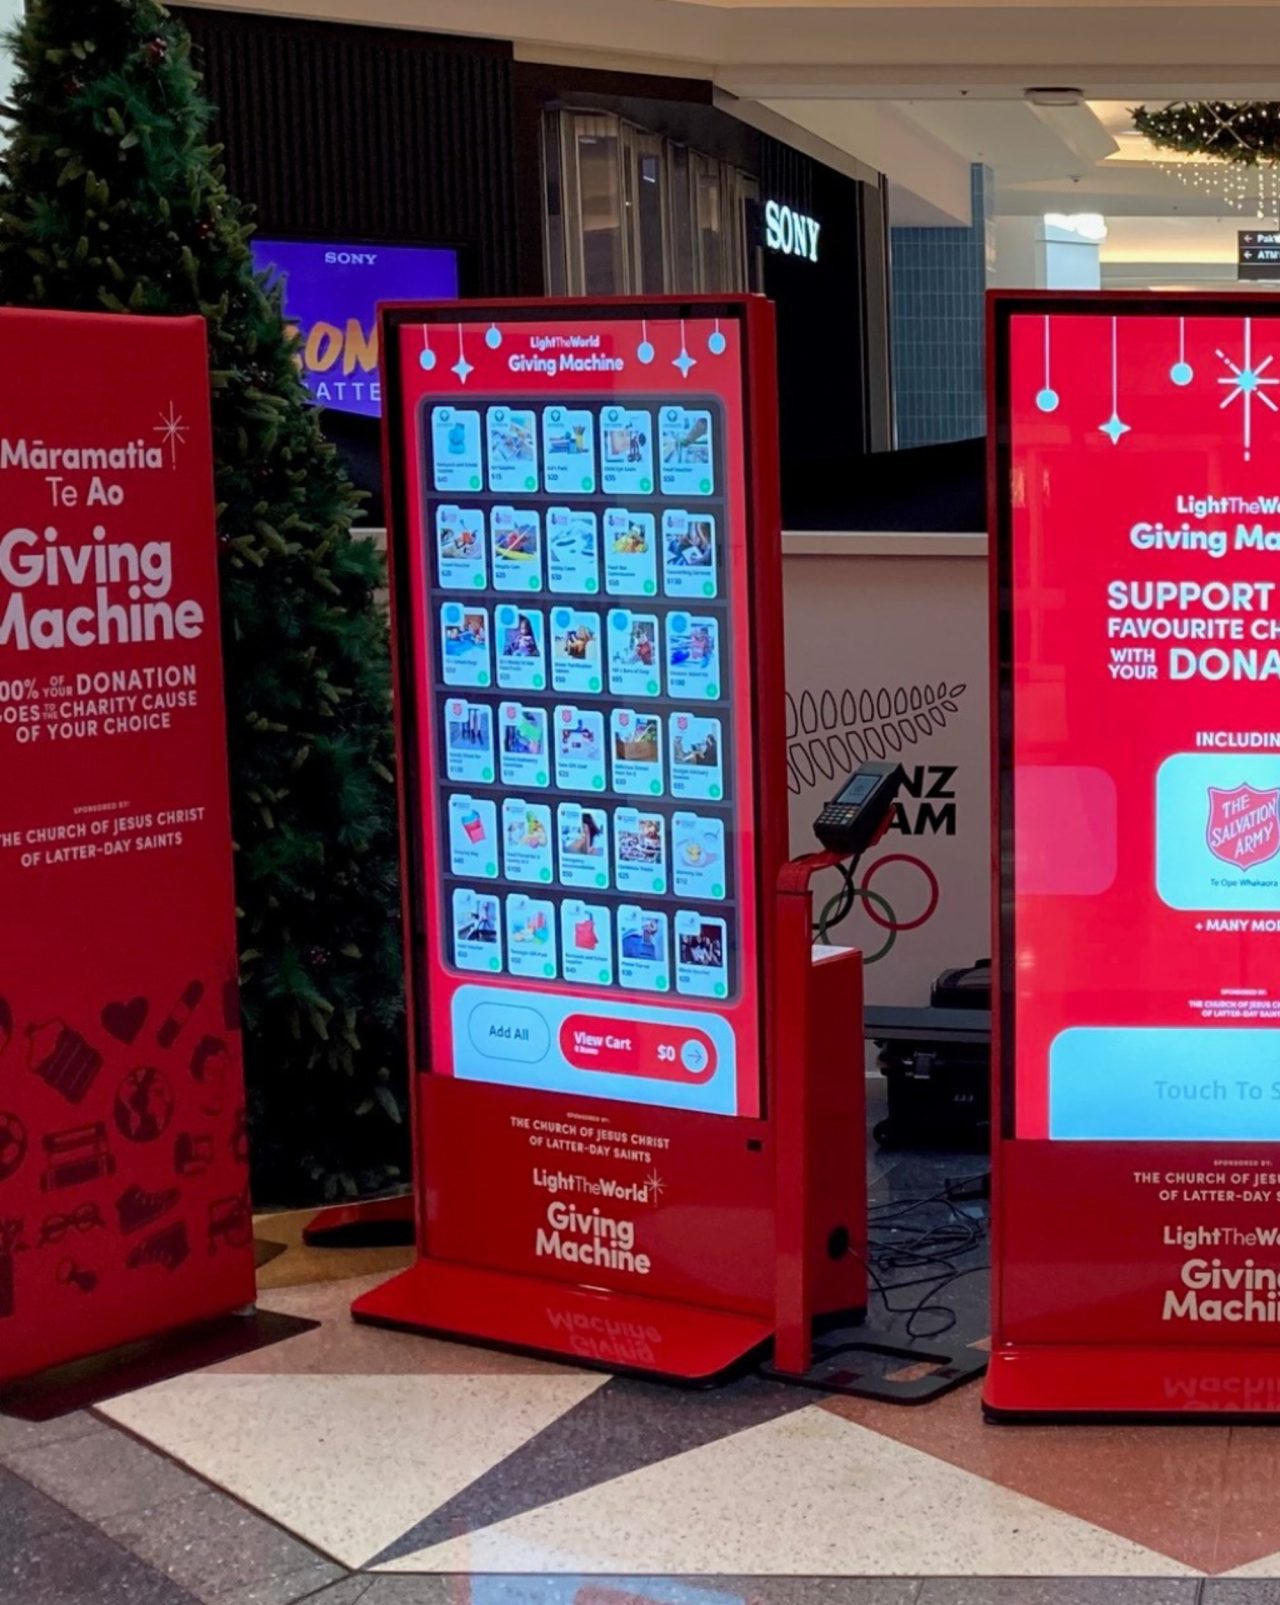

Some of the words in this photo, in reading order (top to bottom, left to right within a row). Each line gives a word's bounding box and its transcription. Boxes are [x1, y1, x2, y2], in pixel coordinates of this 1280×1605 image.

[765, 200, 821, 263] SONY
[324, 251, 378, 265] SONY
[530, 335, 600, 352] LightTheWorld
[508, 353, 557, 377] Giving
[559, 353, 624, 371] Machine
[302, 381, 381, 402] ATTE
[1, 438, 162, 470] Māramatia
[45, 476, 78, 507] Te
[86, 476, 124, 507] Ao
[1129, 522, 1227, 559] Giving
[0, 525, 172, 599] Giving
[1107, 580, 1275, 611] SUPPORT
[0, 586, 204, 650] Machine
[1107, 617, 1244, 640] FAVOURITE
[1110, 648, 1156, 663] WITH
[49, 675, 65, 687] OF
[76, 664, 197, 696] DONATION
[1108, 664, 1158, 680] YOUR
[0, 678, 39, 702] 00%
[42, 685, 73, 698] YOUR
[59, 696, 137, 719] CHARITY
[141, 690, 197, 711] CAUSE
[16, 725, 40, 743] OF
[47, 720, 98, 741] YOUR
[103, 712, 171, 735] CHOICE
[1222, 793, 1250, 819] THE
[26, 823, 87, 844] CHURCH
[90, 819, 110, 836] OF
[113, 813, 153, 836] JESUS
[157, 806, 205, 825] CHRIST
[1211, 798, 1277, 848] SALVATION
[20, 851, 41, 868] OF
[45, 838, 132, 865] LATTER-DAY
[135, 831, 183, 851] SAINTS
[1234, 821, 1274, 859] ARMY
[1210, 878, 1220, 887] Te
[1206, 919, 1250, 932] MANY
[1201, 1010, 1212, 1018] OF
[489, 1025, 511, 1039] Add
[513, 1027, 530, 1041] All
[573, 1031, 602, 1047] View
[604, 1035, 632, 1051] Cart
[657, 1044, 676, 1062] $0
[1153, 1079, 1227, 1101] Touch
[1235, 1081, 1263, 1101] To
[510, 1116, 531, 1129] THE
[532, 1119, 577, 1136] CHURCH
[579, 1126, 594, 1137] OF
[596, 1129, 628, 1144] JESUS
[630, 1134, 670, 1149] CHRIST
[529, 1135, 544, 1147] OF
[546, 1138, 611, 1156] LATTER-DAY
[613, 1147, 652, 1163] SAINTS
[533, 1167, 649, 1203] LightTheWorld
[1133, 1172, 1160, 1184] THE
[1164, 1172, 1225, 1184] CHURCH
[1230, 1172, 1250, 1184] OF
[1158, 1189, 1179, 1202] OF
[1183, 1189, 1271, 1202] LATTER-DAY
[547, 1201, 634, 1250] Giving
[536, 1228, 651, 1275] Machine
